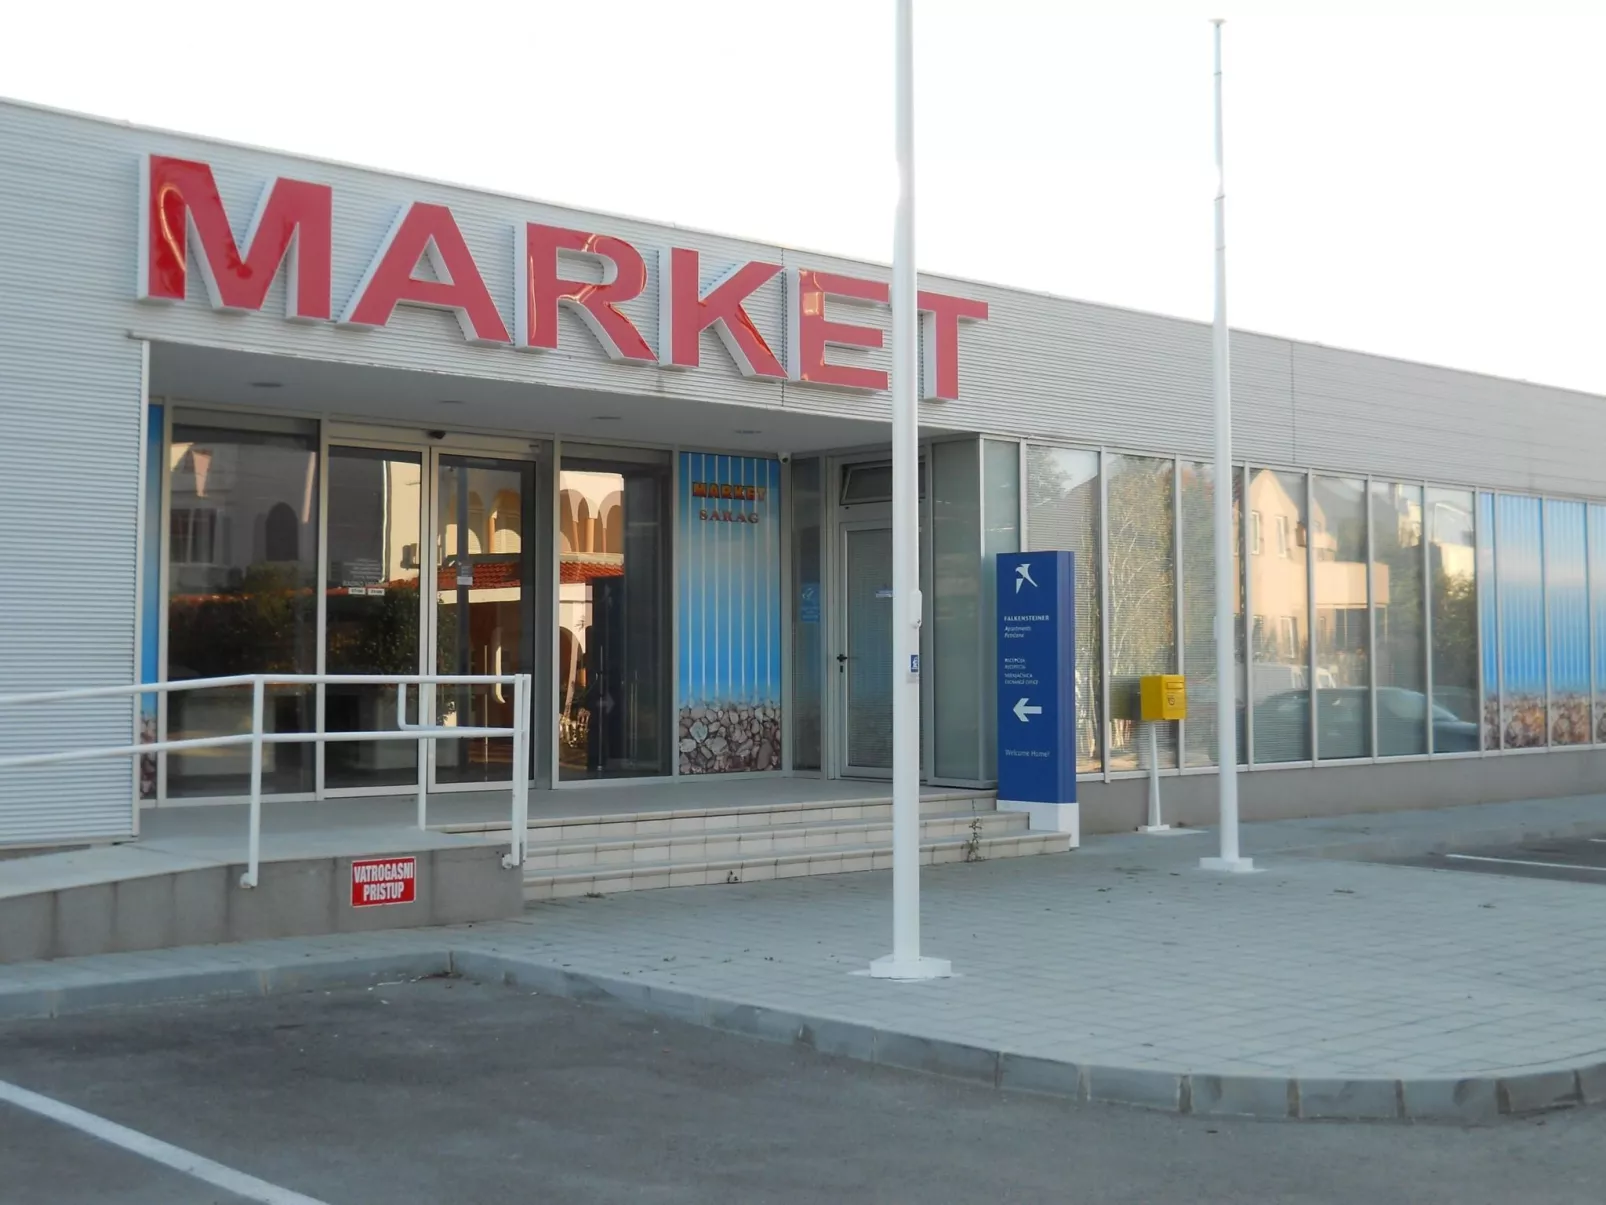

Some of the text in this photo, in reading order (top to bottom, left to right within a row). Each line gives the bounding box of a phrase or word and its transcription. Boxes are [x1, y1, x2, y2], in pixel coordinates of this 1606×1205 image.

[138, 154, 988, 402] MARKET
[692, 481, 766, 501] MARKET
[1004, 749, 1030, 757] Welcome
[353, 862, 414, 883] VATROGASNI
[363, 881, 405, 902] PRISTUP
